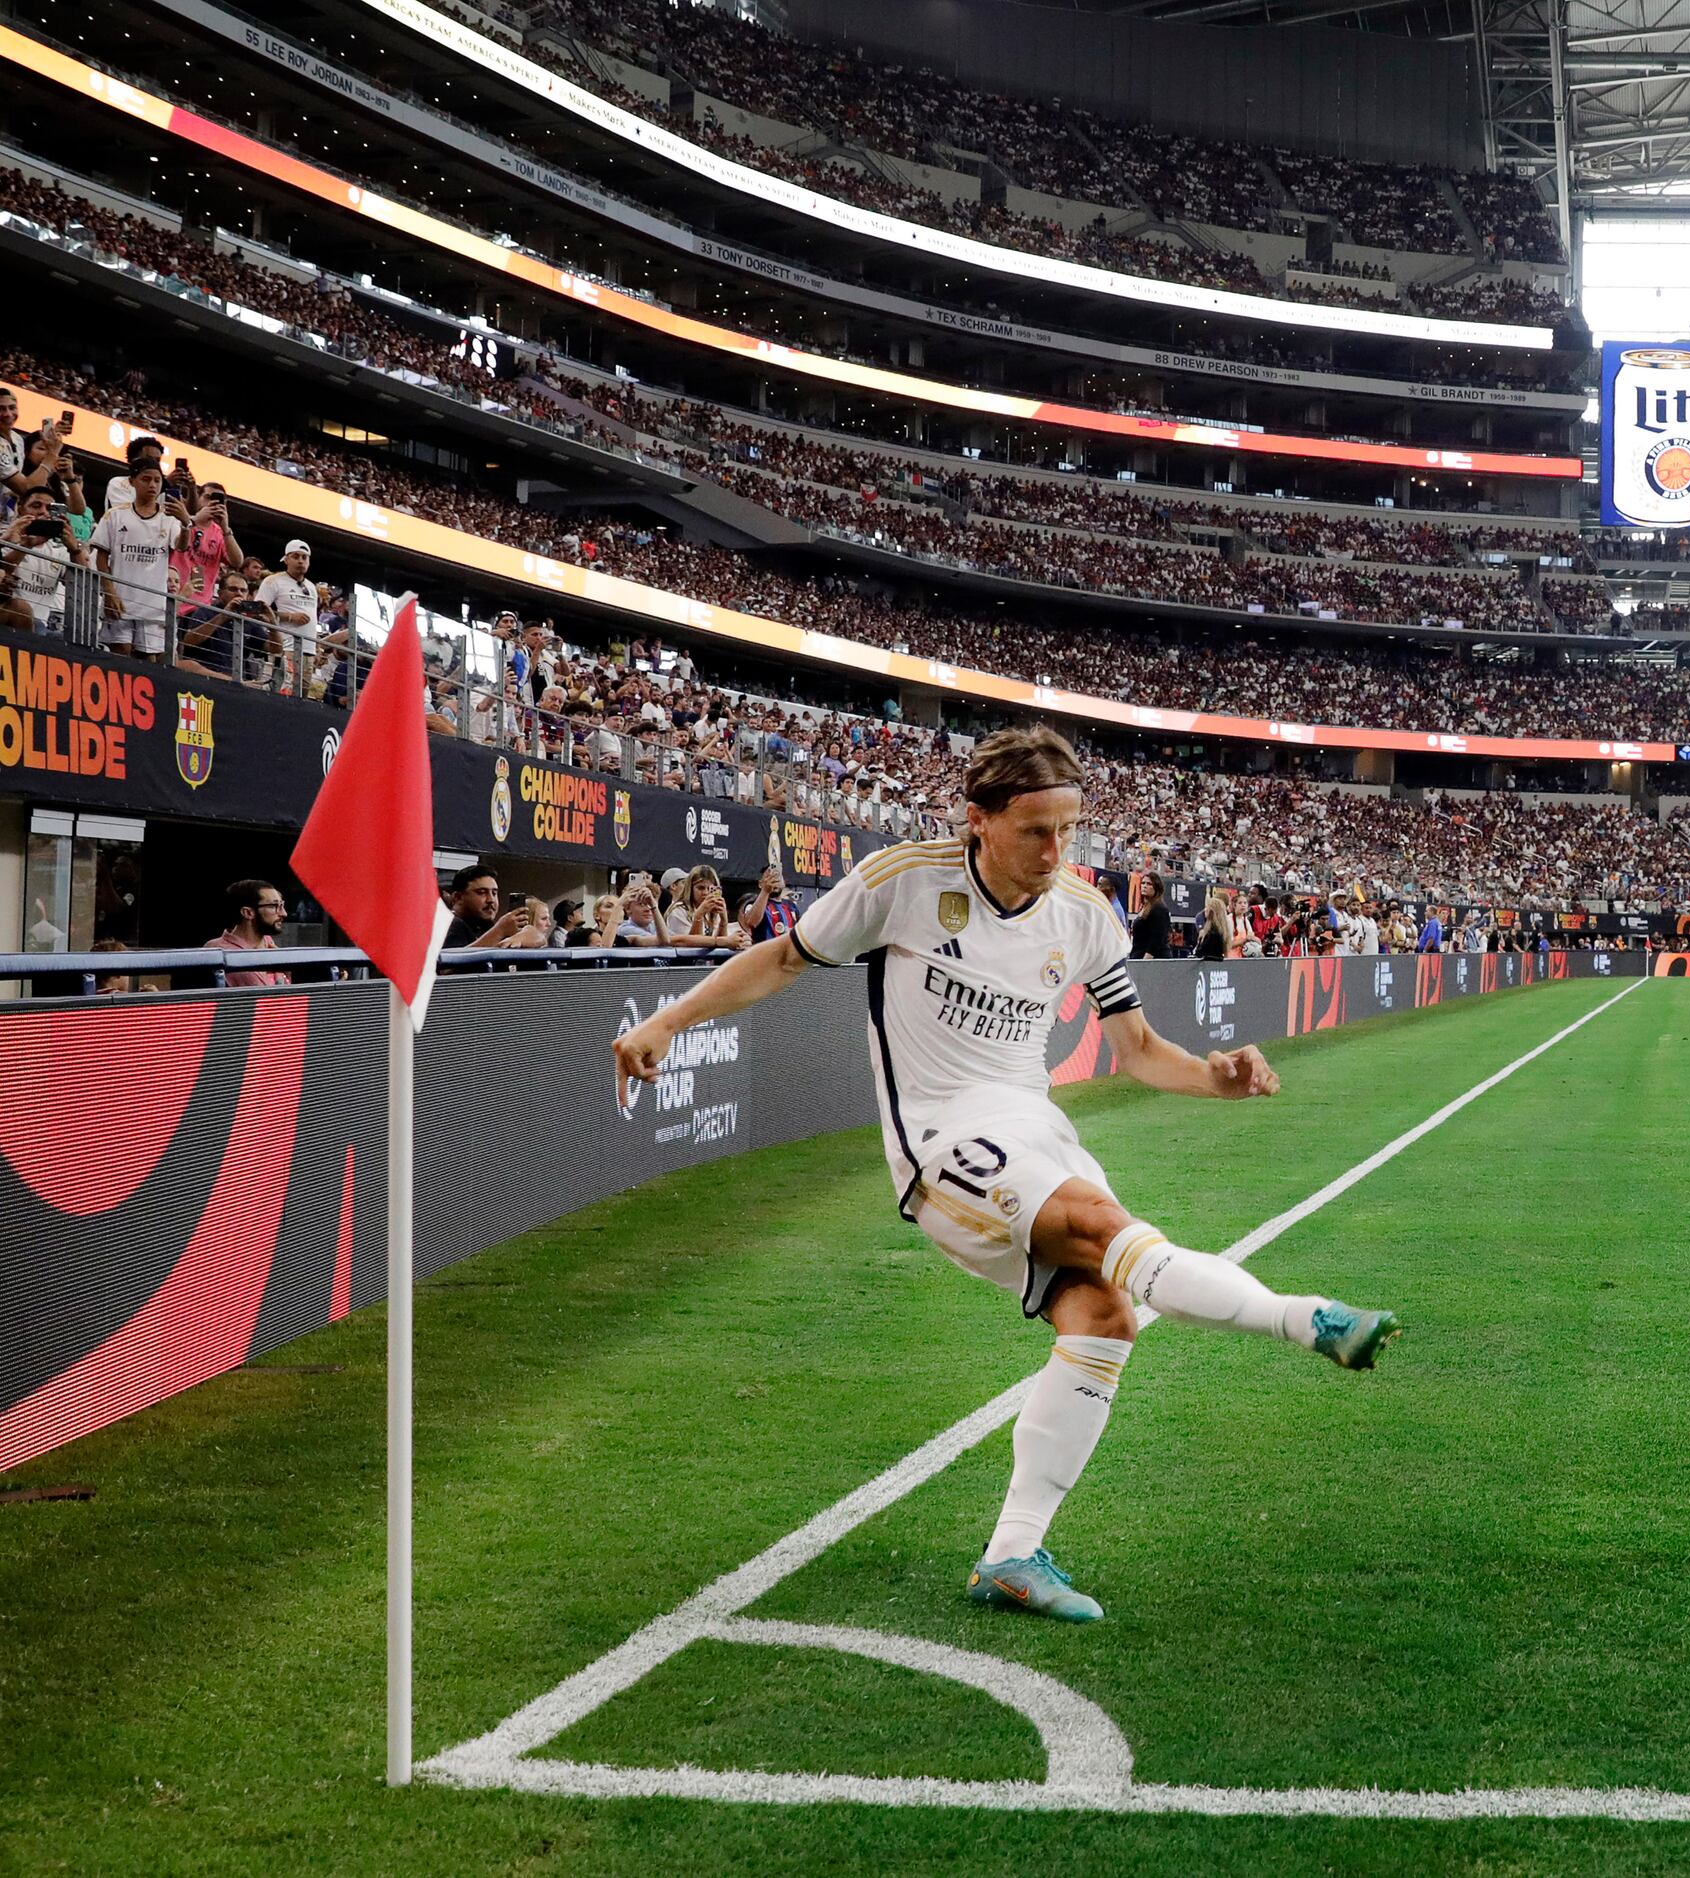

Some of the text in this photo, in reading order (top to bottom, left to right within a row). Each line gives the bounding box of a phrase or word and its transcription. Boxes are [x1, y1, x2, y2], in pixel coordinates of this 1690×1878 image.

[246, 29, 260, 46] 55
[265, 39, 285, 60] LEE
[288, 49, 308, 71] ROY
[311, 65, 353, 94] JORDAN
[514, 159, 535, 179] TOM
[537, 170, 574, 197] LANDRY
[700, 242, 713, 255] 33
[717, 246, 743, 265] TONY
[746, 258, 791, 280] DORSETT
[937, 310, 956, 325] TEX
[960, 317, 1013, 337] SCHRAMM
[1155, 353, 1169, 364] 88
[1173, 355, 1205, 370] DREW
[1208, 361, 1259, 378] PEARSON
[1420, 387, 1438, 397] GIL
[1441, 388, 1486, 401] BRANDT
[187, 731, 203, 745] FCB
[520, 765, 608, 816] CHAMPIONS
[534, 803, 595, 846] COLLIDE
[701, 809, 721, 824] SOCCER
[701, 833, 715, 846] TOUR
[784, 820, 837, 855] CHAMPONS
[794, 847, 832, 877] COLLDE
[924, 964, 1049, 1020] Emirates
[937, 1004, 1032, 1042] FLY BETTER
[656, 1026, 739, 1072] HAMPIONS
[654, 1071, 694, 1112] TOUR
[938, 1137, 1007, 1199] 10
